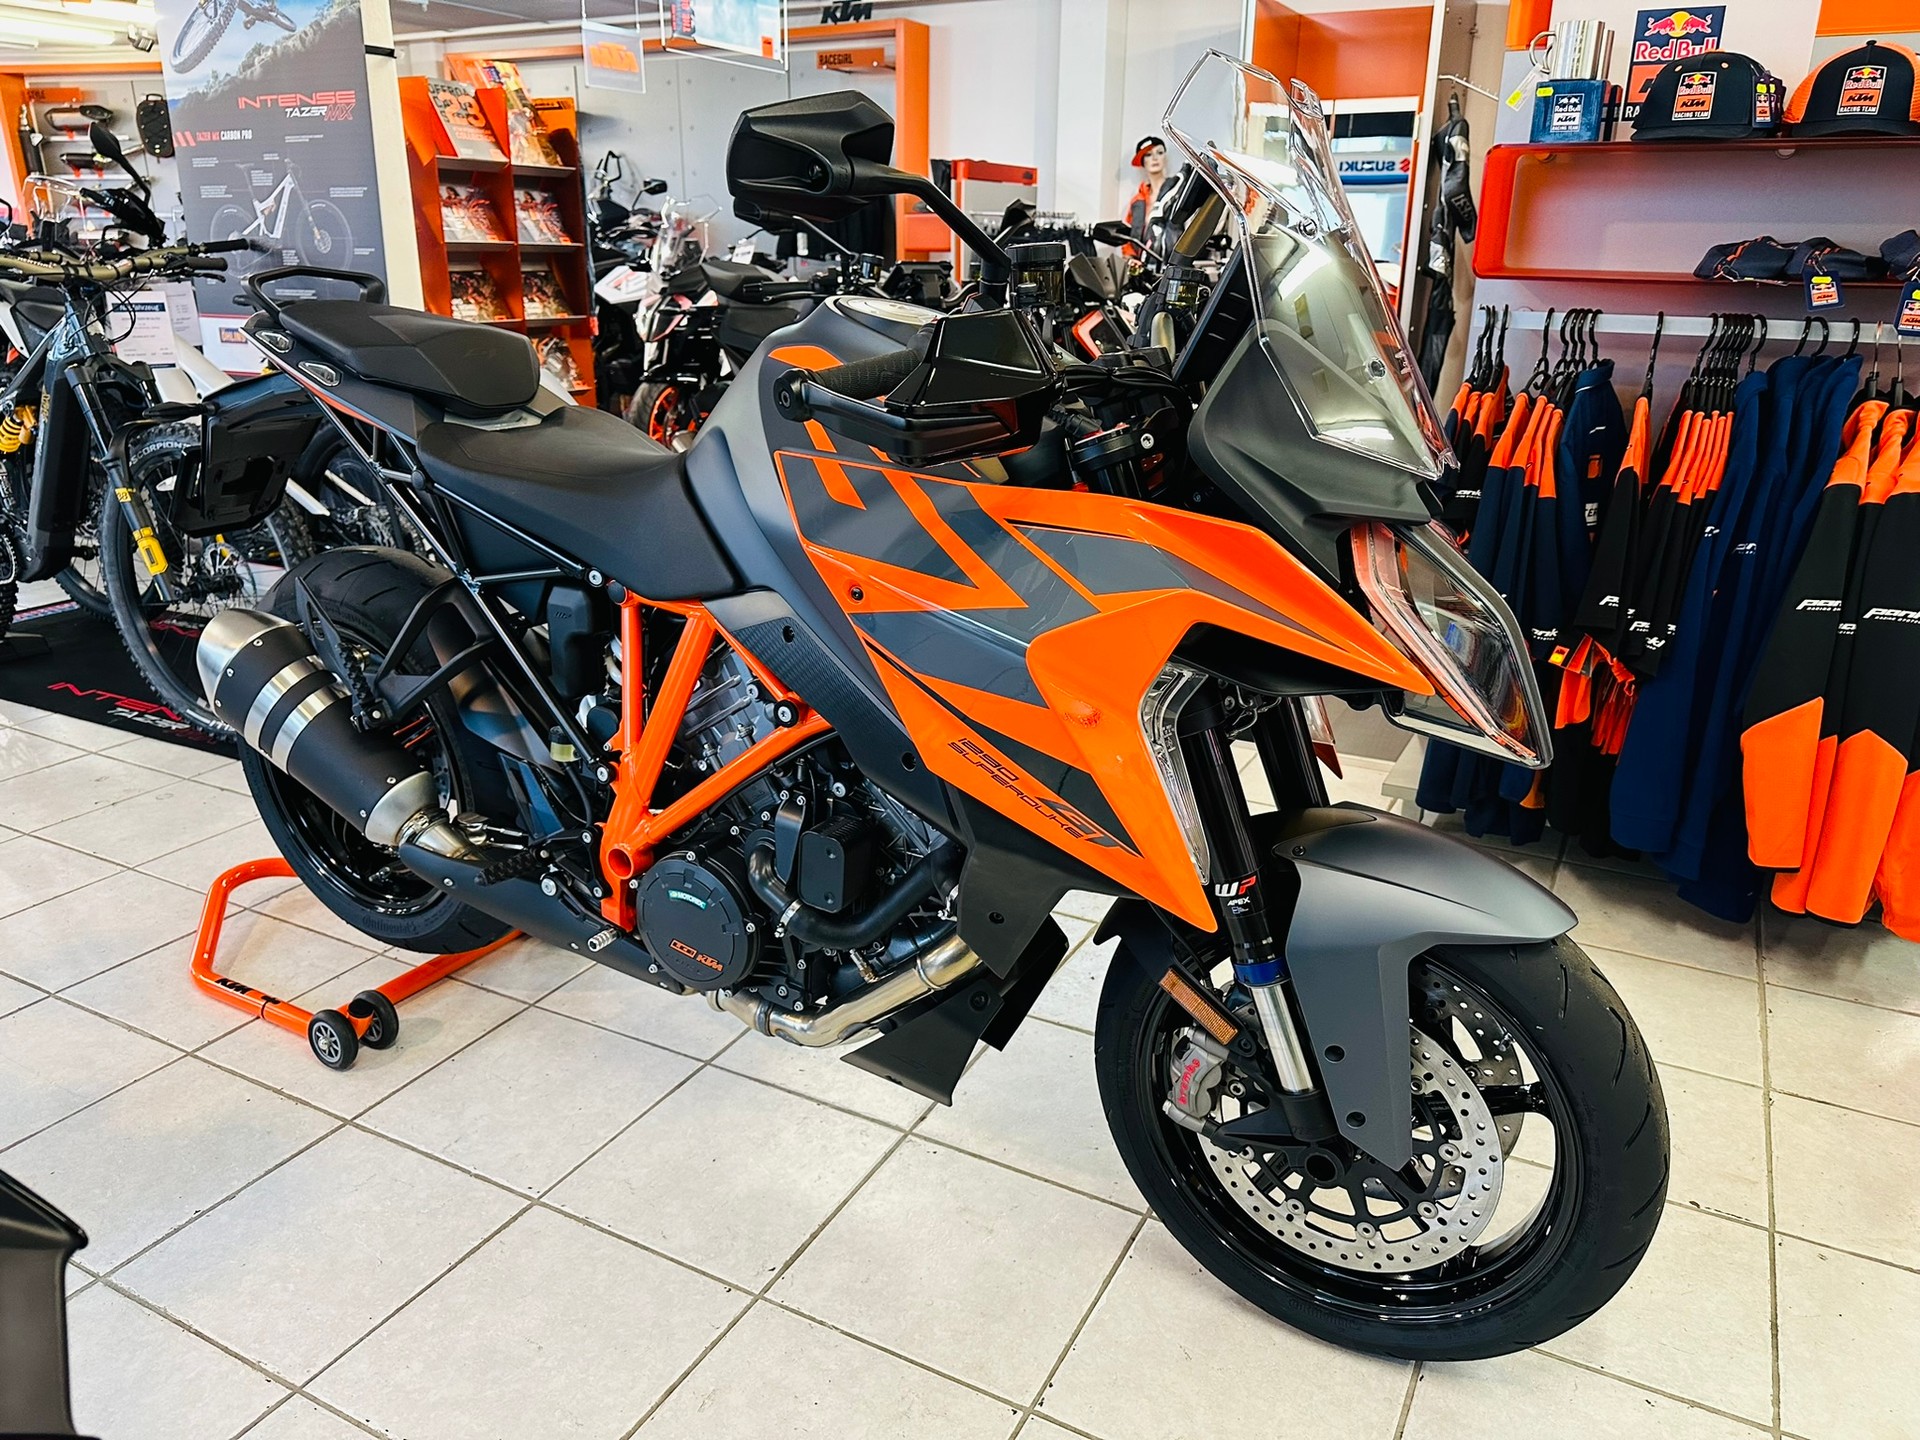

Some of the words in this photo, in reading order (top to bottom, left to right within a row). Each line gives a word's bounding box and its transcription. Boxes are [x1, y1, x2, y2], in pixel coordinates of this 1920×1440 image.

[821, 0, 873, 24] KTM
[818, 53, 853, 65] RACEGIRL
[1633, 39, 1677, 62] Red
[238, 90, 357, 110] INTENSE
[1680, 98, 1706, 108] KTM
[1847, 92, 1875, 102] KTM
[284, 105, 327, 118] TAZER
[1557, 115, 1576, 123] KTM
[220, 130, 241, 141] CARBON
[241, 129, 253, 140] PRO
[1796, 599, 1842, 611] pan
[47, 682, 182, 721] INTEN
[958, 737, 1019, 782] 1290
[947, 741, 1083, 839] SUPERDUKE
[1214, 875, 1257, 897] WP
[1227, 896, 1250, 907] APEX
[696, 954, 724, 972] KTM
[1178, 1058, 1200, 1105] brembo
